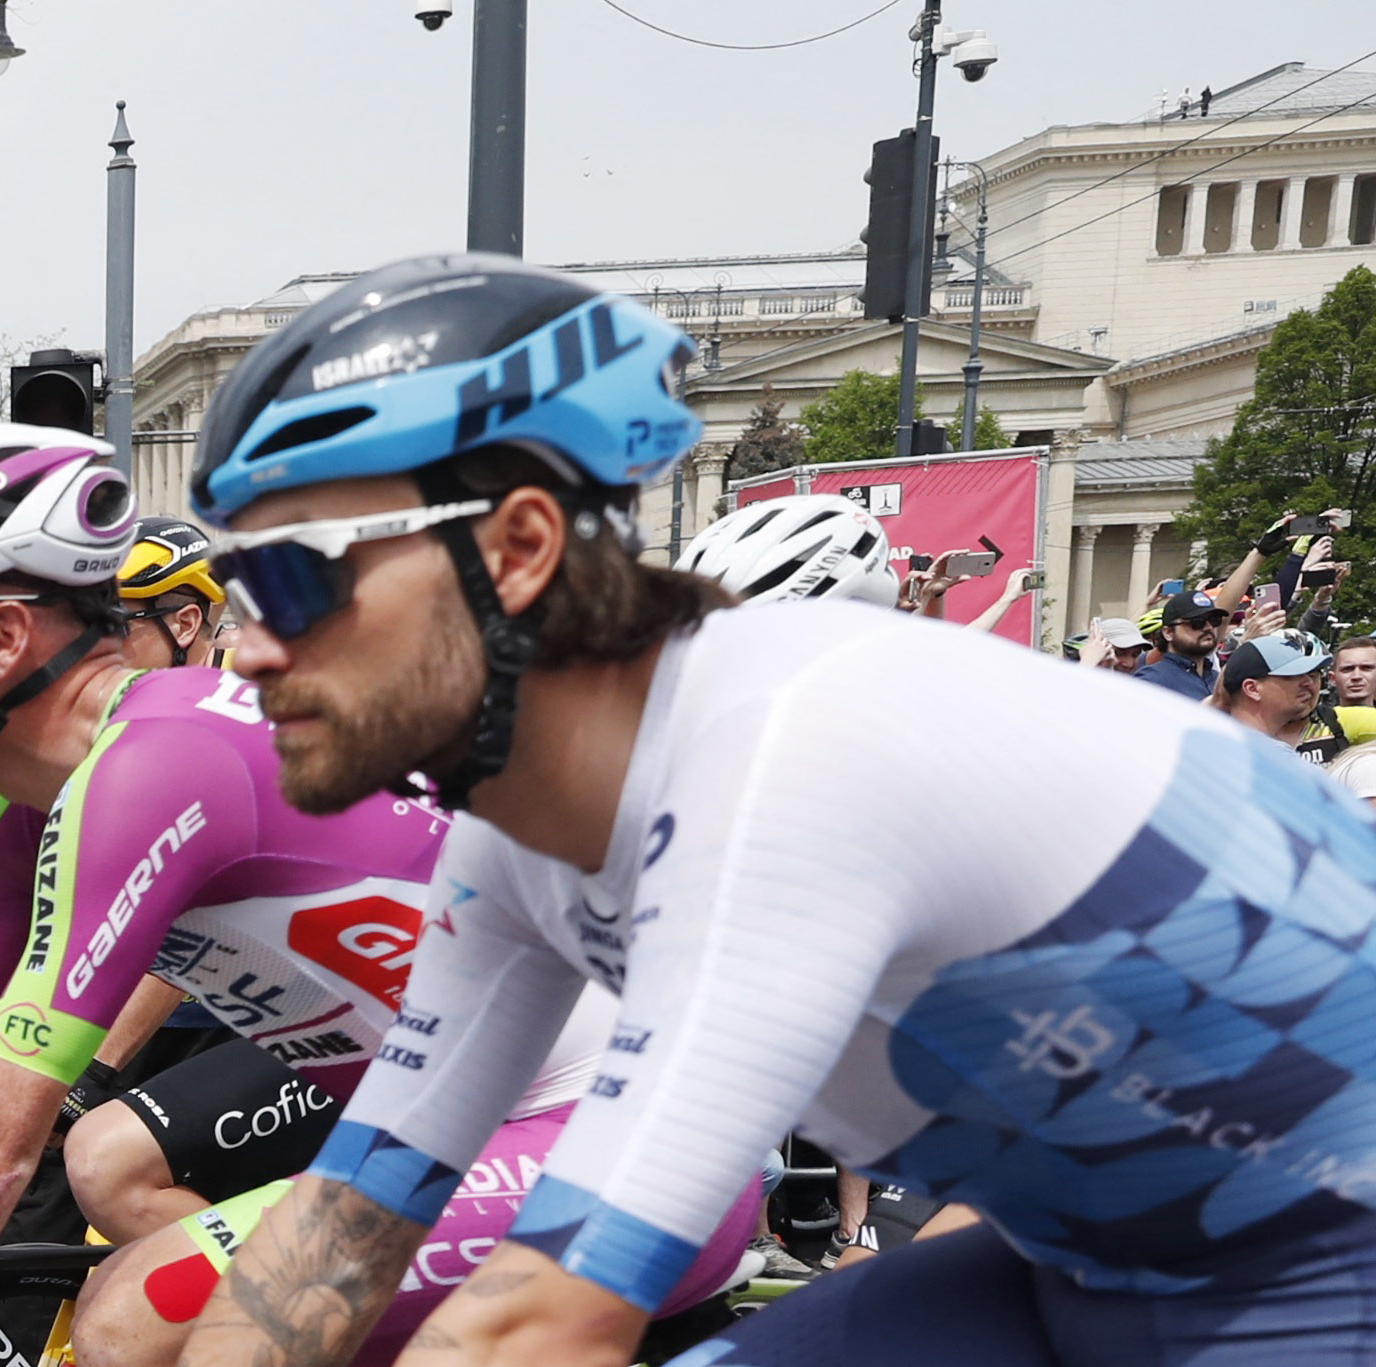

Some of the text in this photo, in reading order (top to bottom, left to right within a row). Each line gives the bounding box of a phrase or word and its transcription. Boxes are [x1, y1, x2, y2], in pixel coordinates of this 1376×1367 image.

[5, 1014, 53, 1048] FTC
[139, 1090, 171, 1129] ROSA
[1110, 1072, 1284, 1162] BLACK
